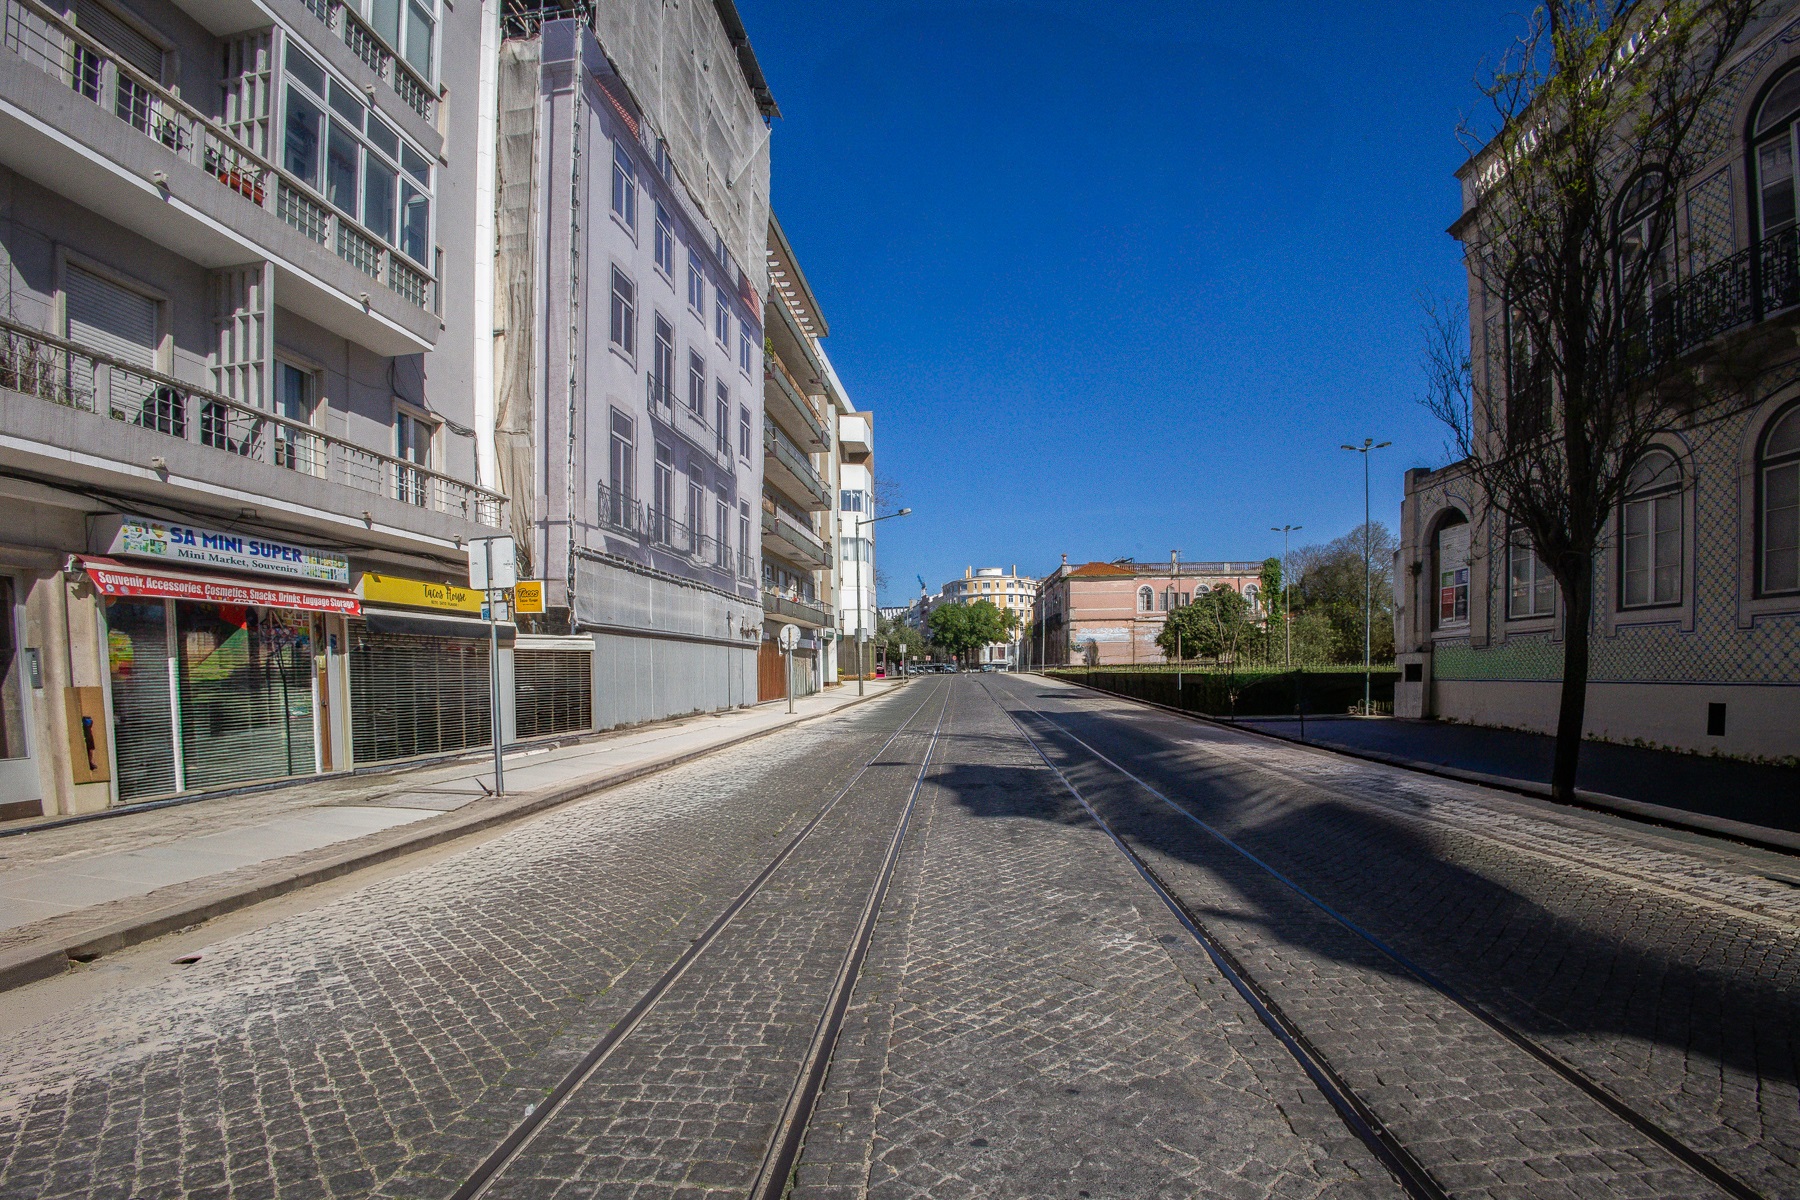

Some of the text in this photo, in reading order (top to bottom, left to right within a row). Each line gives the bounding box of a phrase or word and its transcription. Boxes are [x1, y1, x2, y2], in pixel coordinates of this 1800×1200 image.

[170, 527, 303, 563] SA MINI SUPER
[178, 549, 298, 574] Mini Market, Souvenirs
[98, 571, 145, 588] Souvenir,
[146, 578, 203, 595] Accessories,
[205, 584, 249, 599] Cosmetics,
[249, 589, 278, 602] Snacks,
[279, 592, 302, 604] Drinks,
[303, 596, 329, 607] Luggage
[330, 598, 355, 610] Storage
[422, 584, 467, 602] Tacos House
[518, 588, 539, 598] Tacos
